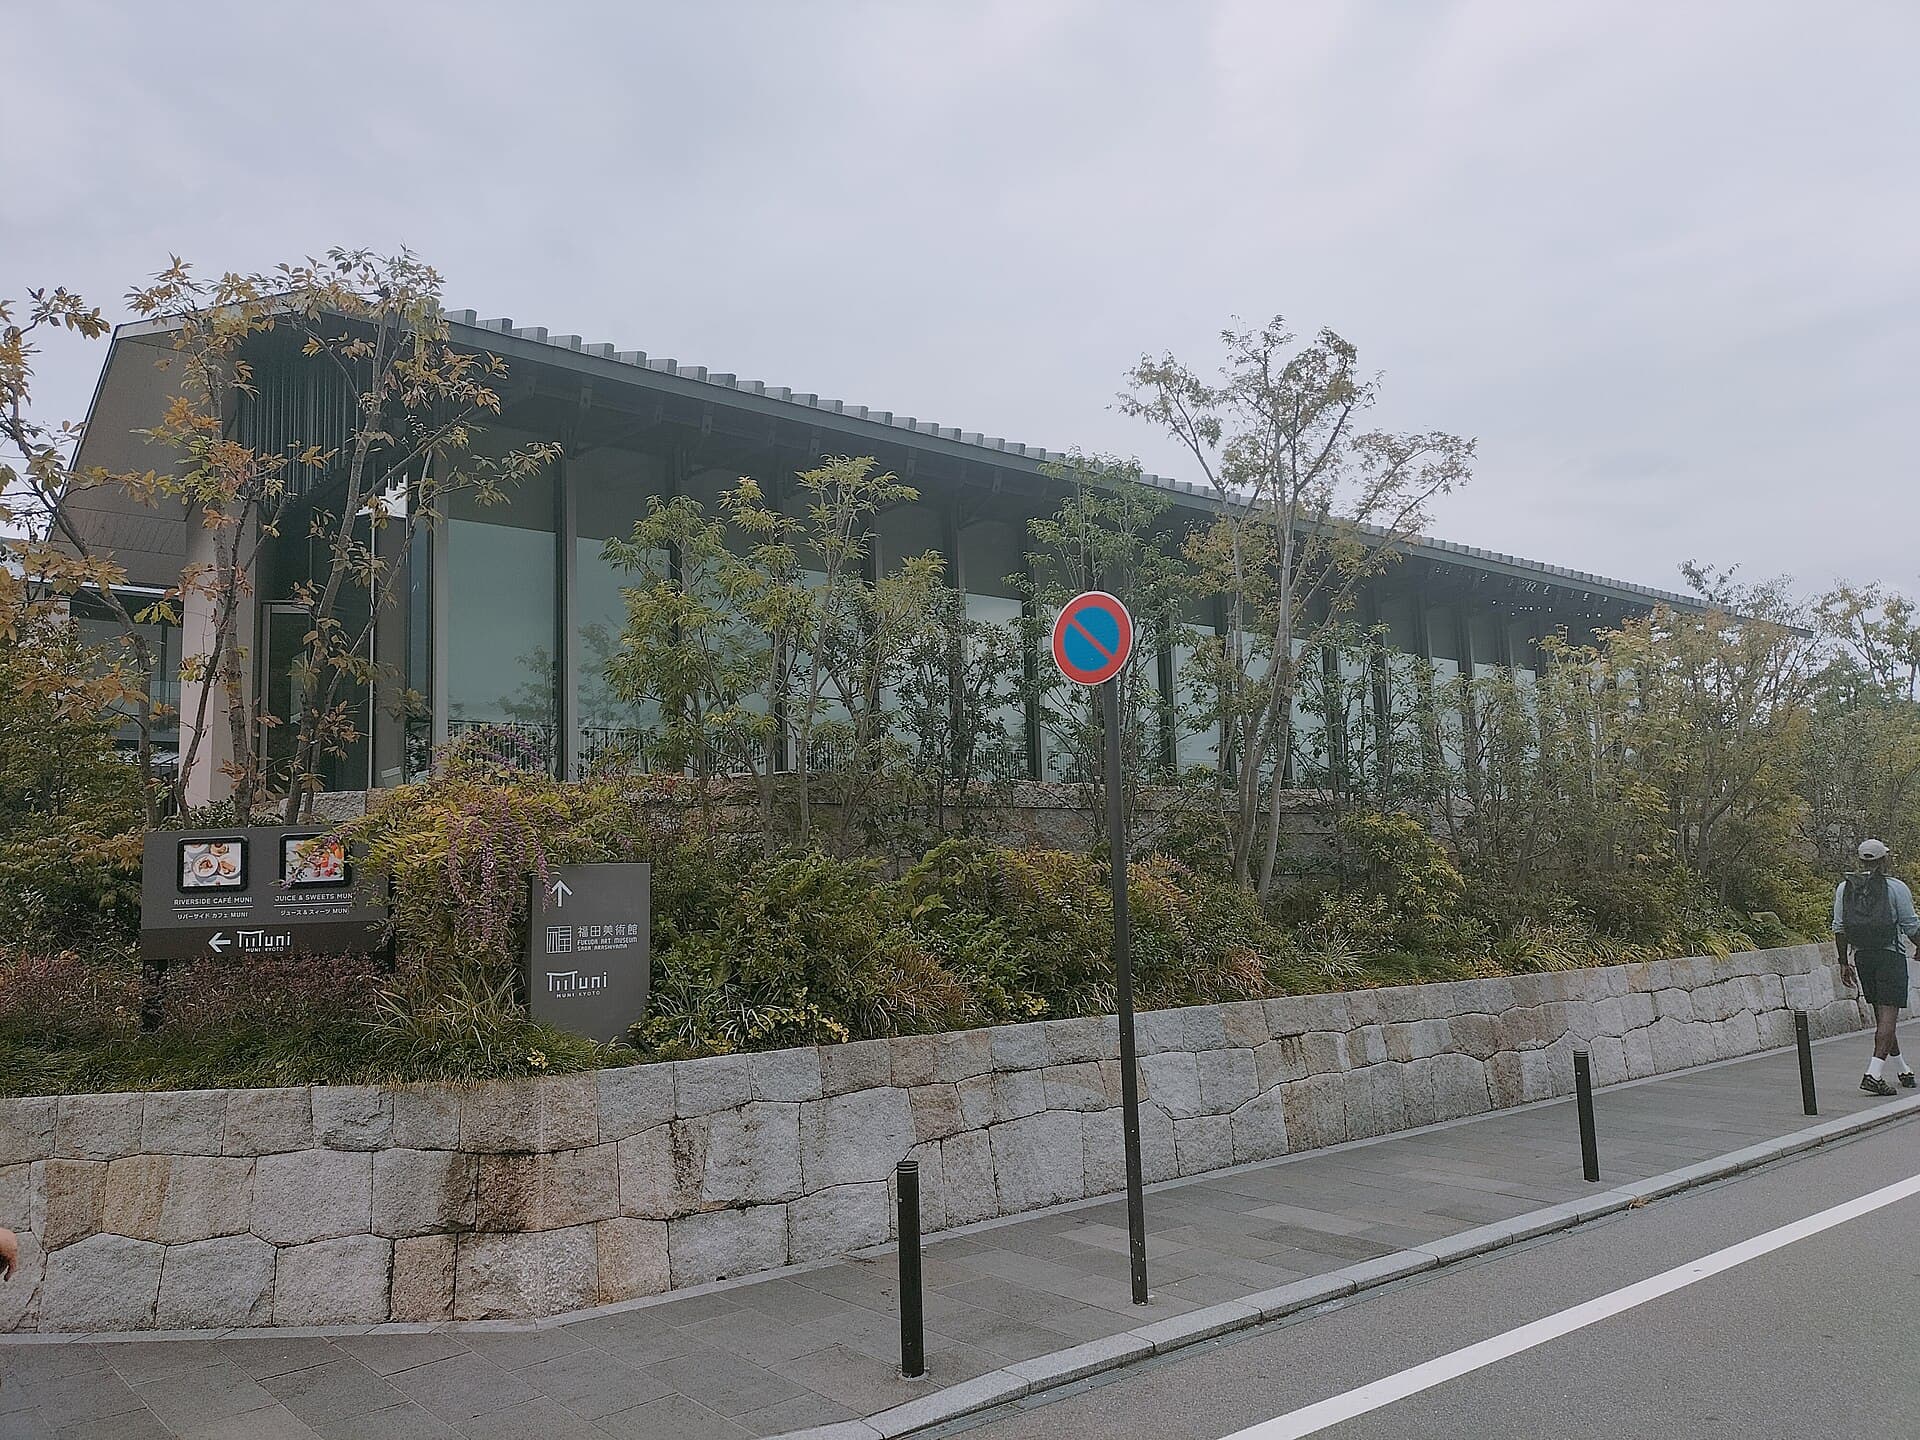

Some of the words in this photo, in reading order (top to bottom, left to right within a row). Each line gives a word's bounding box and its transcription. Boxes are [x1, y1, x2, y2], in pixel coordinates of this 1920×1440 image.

[173, 898, 211, 906] RIVERSIDE
[213, 896, 232, 904] CAFÉ
[233, 896, 253, 904] MUNI
[305, 893, 335, 901] SWEETS
[577, 923, 638, 938] 福田美術館
